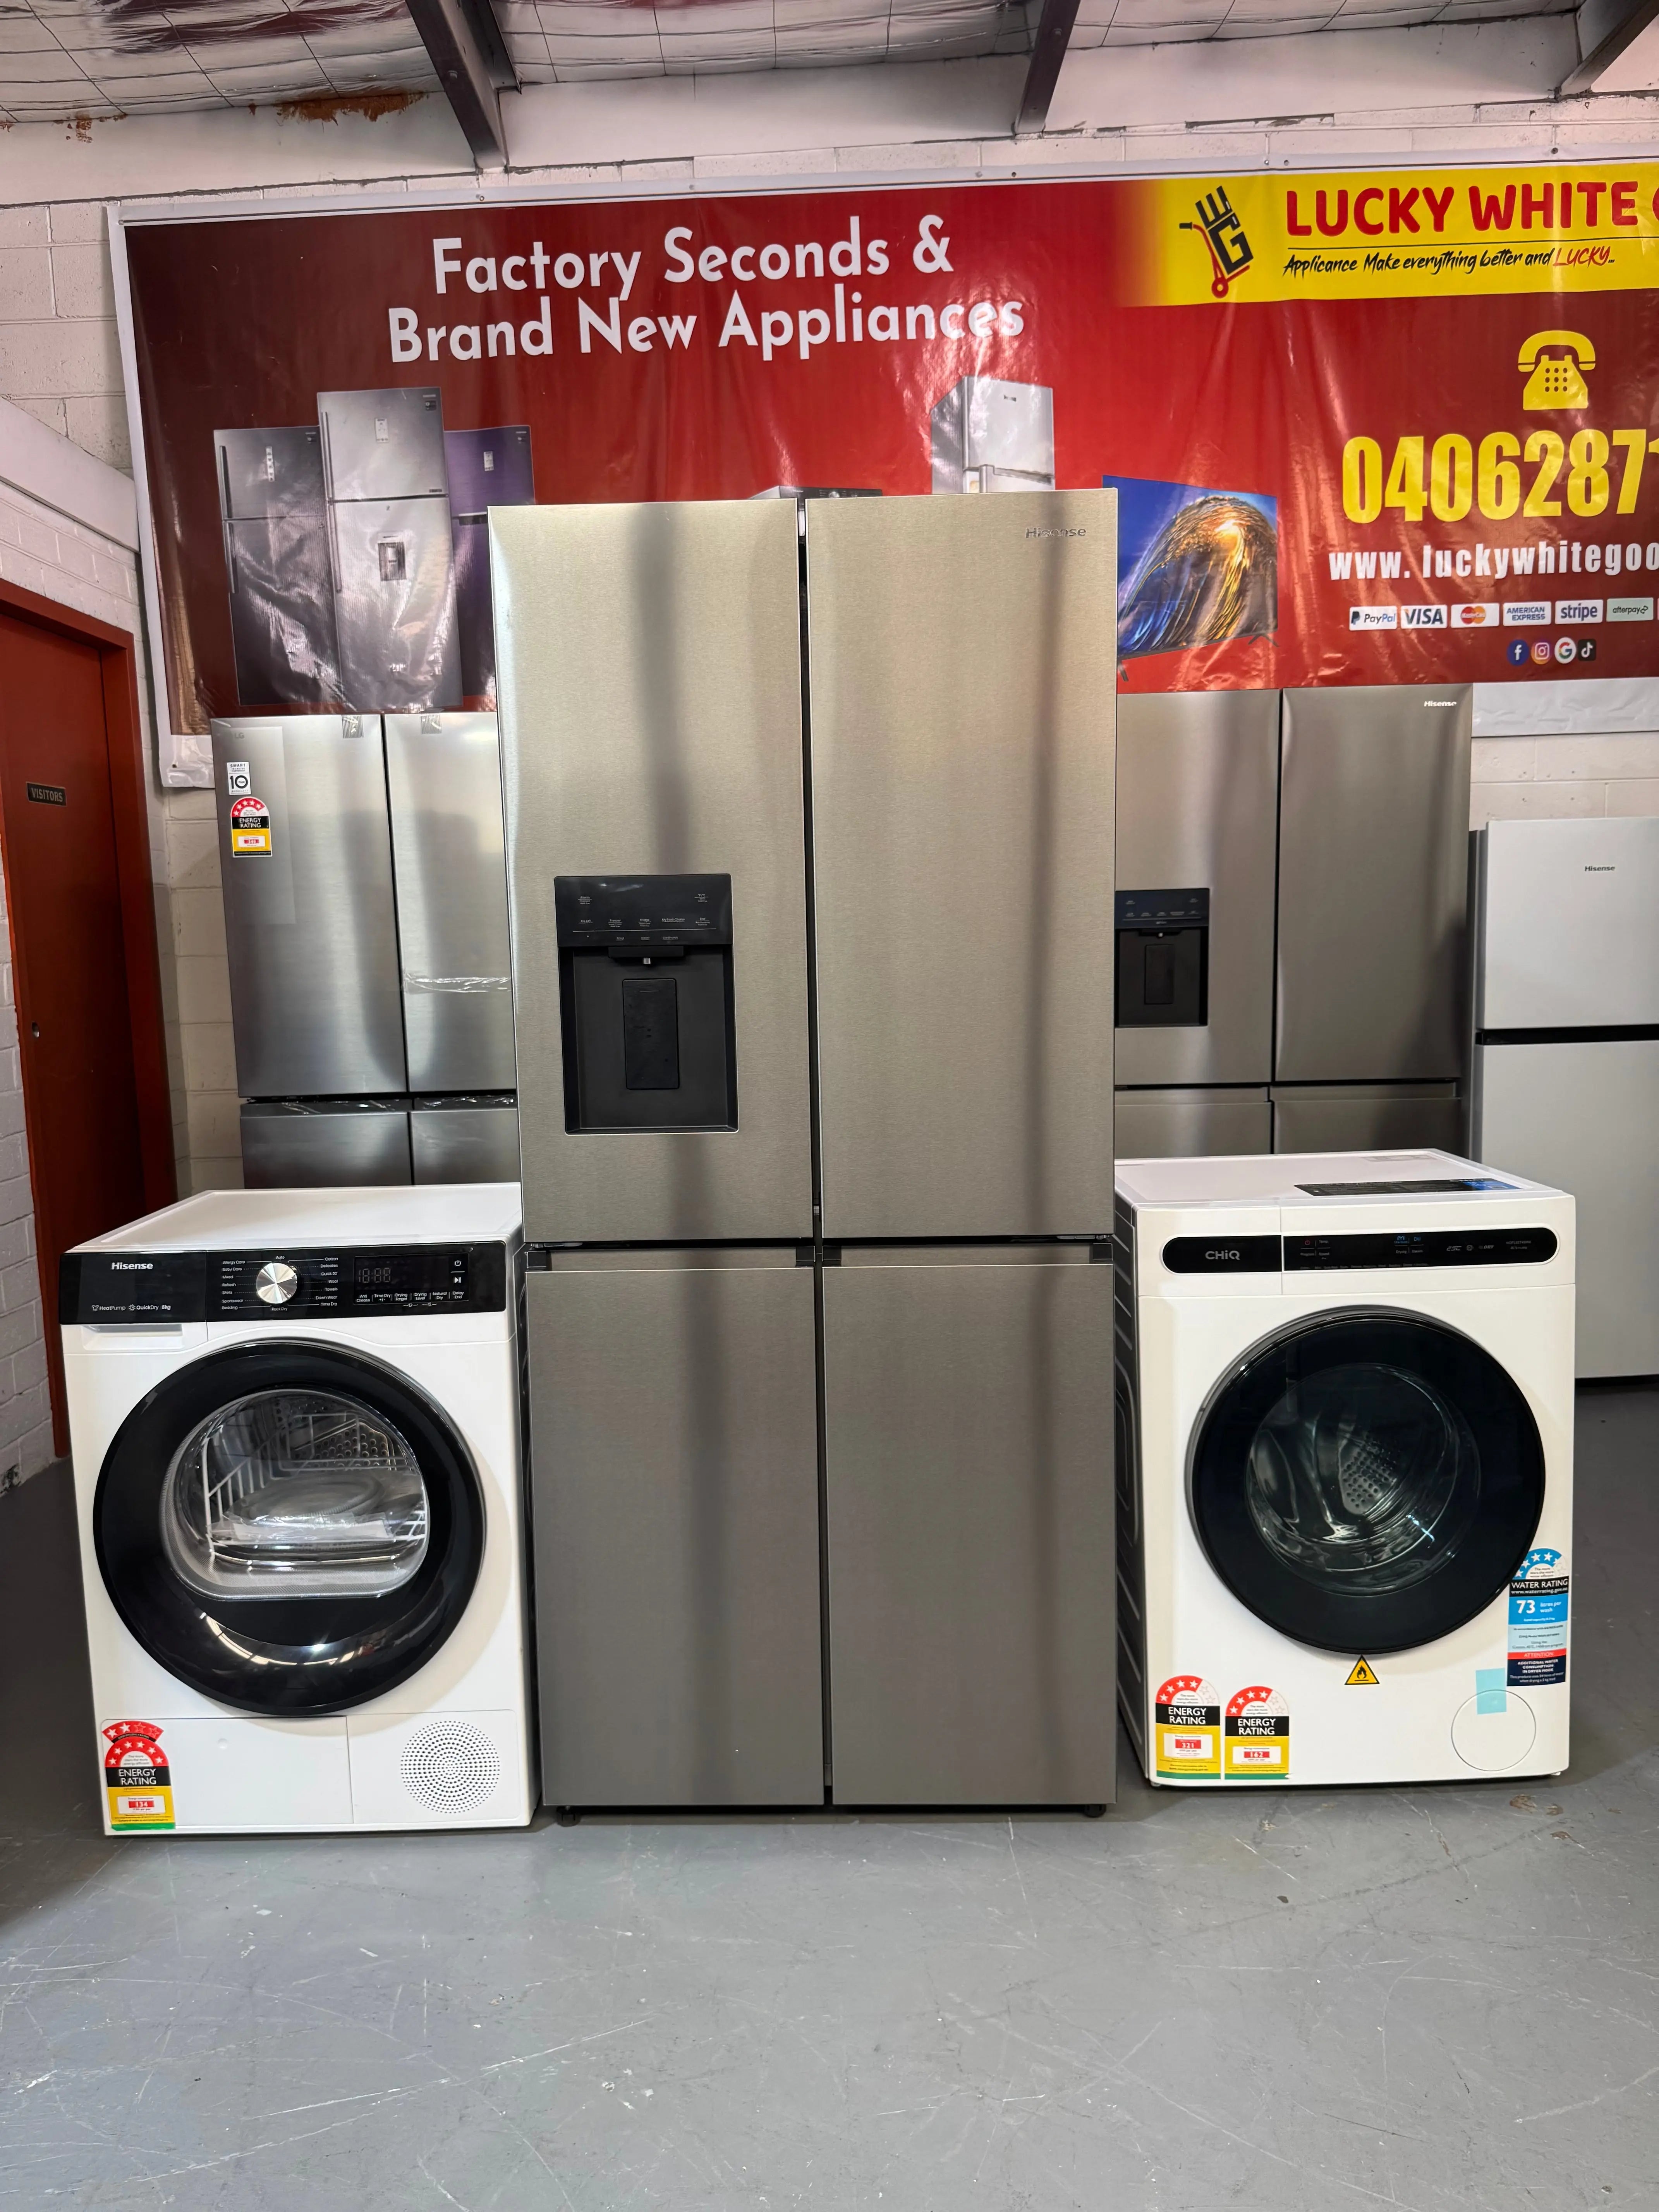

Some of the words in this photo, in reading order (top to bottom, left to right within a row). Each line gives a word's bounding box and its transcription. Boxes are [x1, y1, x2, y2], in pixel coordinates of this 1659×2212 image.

[1286, 187, 1455, 237] LUCKY
[1468, 181, 1638, 230] WHITE
[433, 237, 641, 301] Factory
[665, 216, 889, 283] Seconds
[912, 215, 954, 274] &
[1283, 253, 1357, 278] Applicance
[1364, 254, 1403, 274] Make
[1403, 251, 1476, 275] everything
[1480, 250, 1523, 267] better
[1525, 248, 1554, 266] and
[388, 297, 554, 363] Brand
[580, 297, 697, 354] New
[719, 284, 1024, 360] Appliances
[1342, 429, 1659, 523] 0406287
[1025, 527, 1086, 538] Hisense
[1405, 608, 1443, 625] VISA
[1561, 603, 1597, 621] stripe
[1613, 606, 1640, 615] afterpay
[1364, 613, 1396, 624] PayPal
[230, 775, 248, 789] 10
[31, 787, 63, 802] VISITORS
[1205, 1250, 1240, 1260] CHiQ
[1541, 1578, 1568, 1587] RATING
[1516, 1600, 1535, 1614] 73
[1168, 1707, 1206, 1716] ENERGY
[1170, 1716, 1206, 1724] RATING
[1238, 1718, 1276, 1726] ENERGY
[119, 1769, 156, 1777] ENERGY
[121, 1777, 156, 1785] RATING
